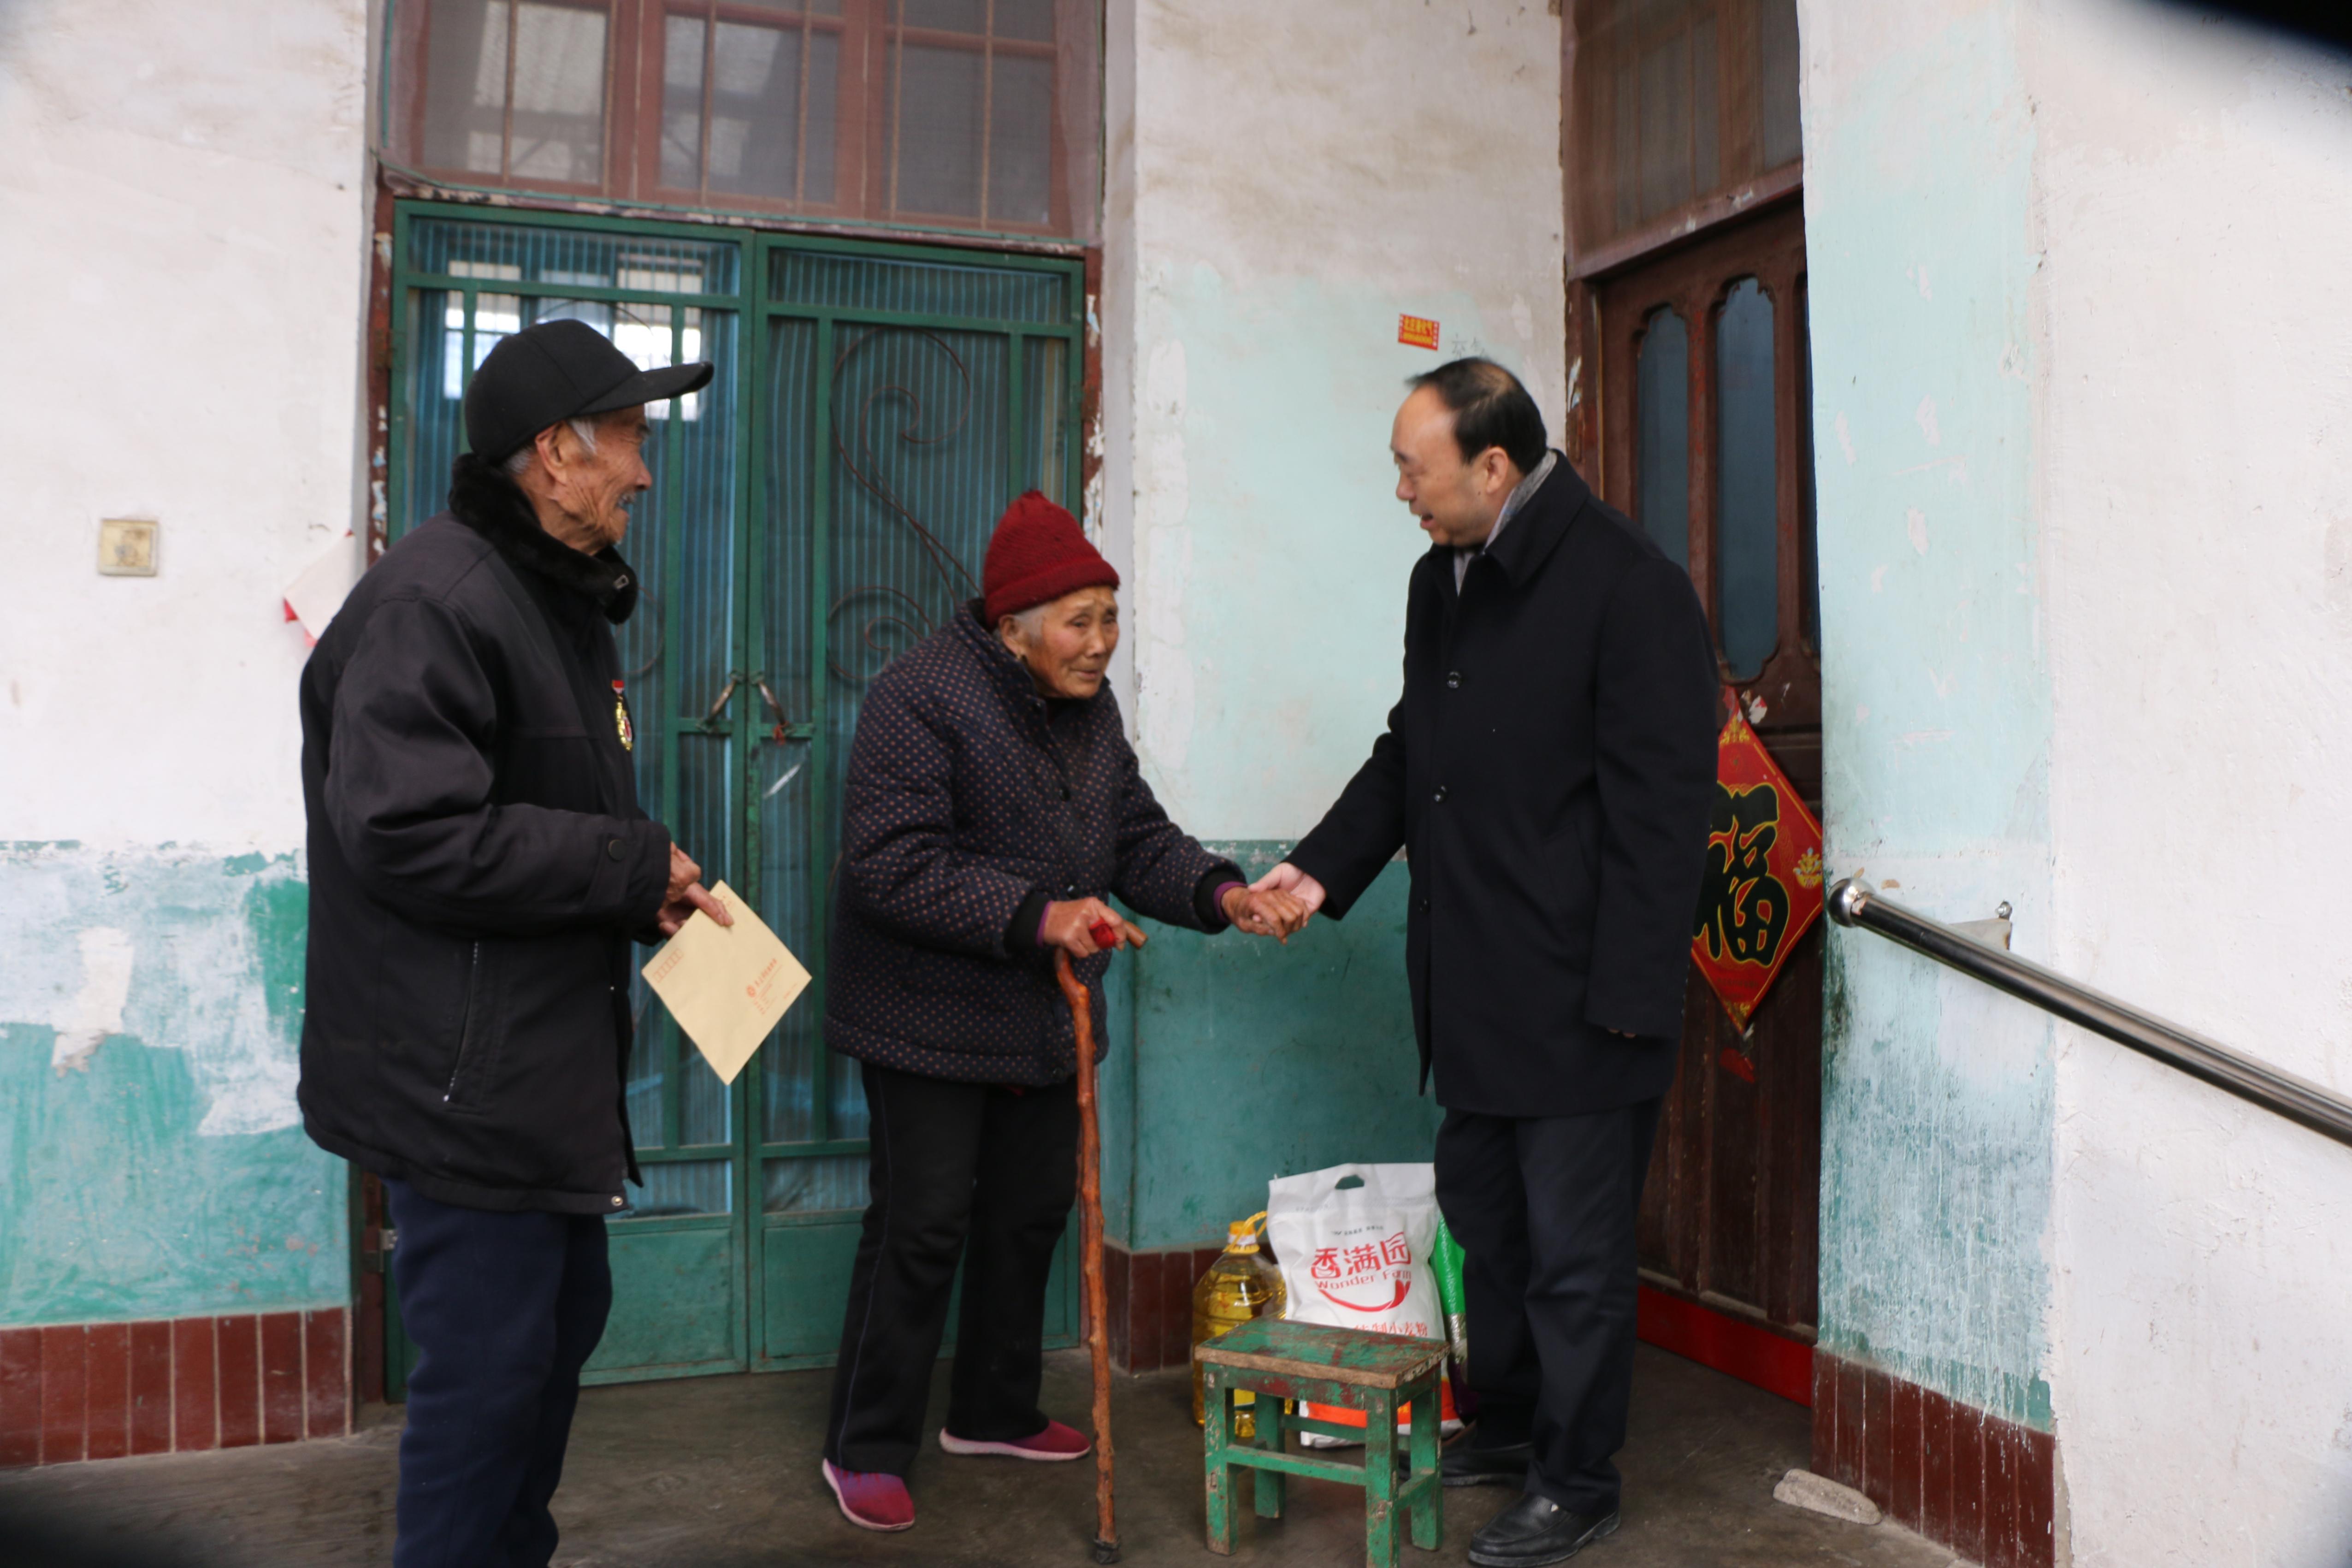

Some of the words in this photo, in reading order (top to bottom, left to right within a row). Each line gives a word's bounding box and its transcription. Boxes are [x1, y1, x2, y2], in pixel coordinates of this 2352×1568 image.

[1693, 780, 1790, 968] 福
[1311, 1231, 1412, 1279] 香满园
[1315, 1274, 1375, 1290] Wonder
[1383, 1269, 1412, 1281] Farm
